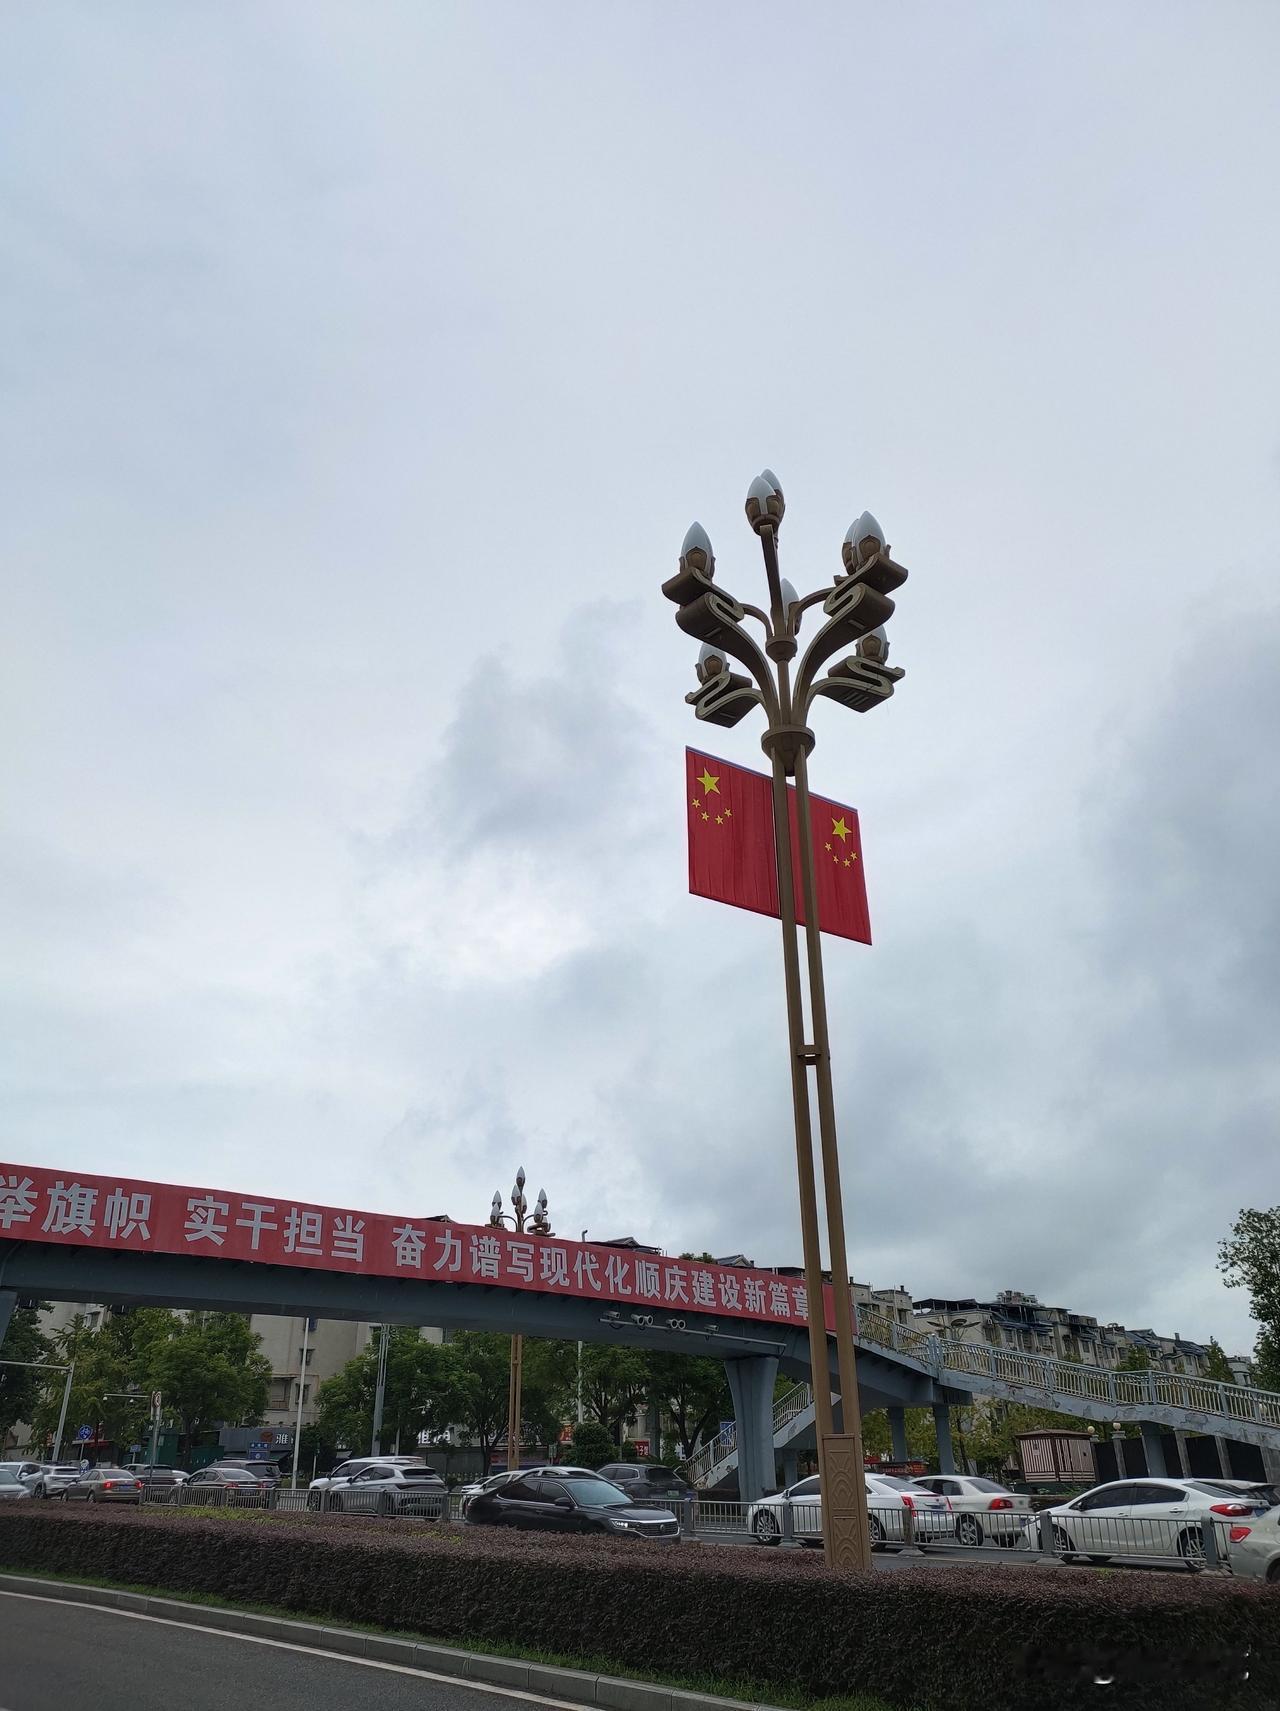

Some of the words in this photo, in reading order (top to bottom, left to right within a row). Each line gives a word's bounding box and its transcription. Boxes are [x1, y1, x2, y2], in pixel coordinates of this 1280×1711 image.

[0, 1175, 152, 1241] 举旗帜
[184, 1195, 367, 1263] 实干担当
[392, 1223, 808, 1321] 奋力谱写现代化顺庆建设新篇章
